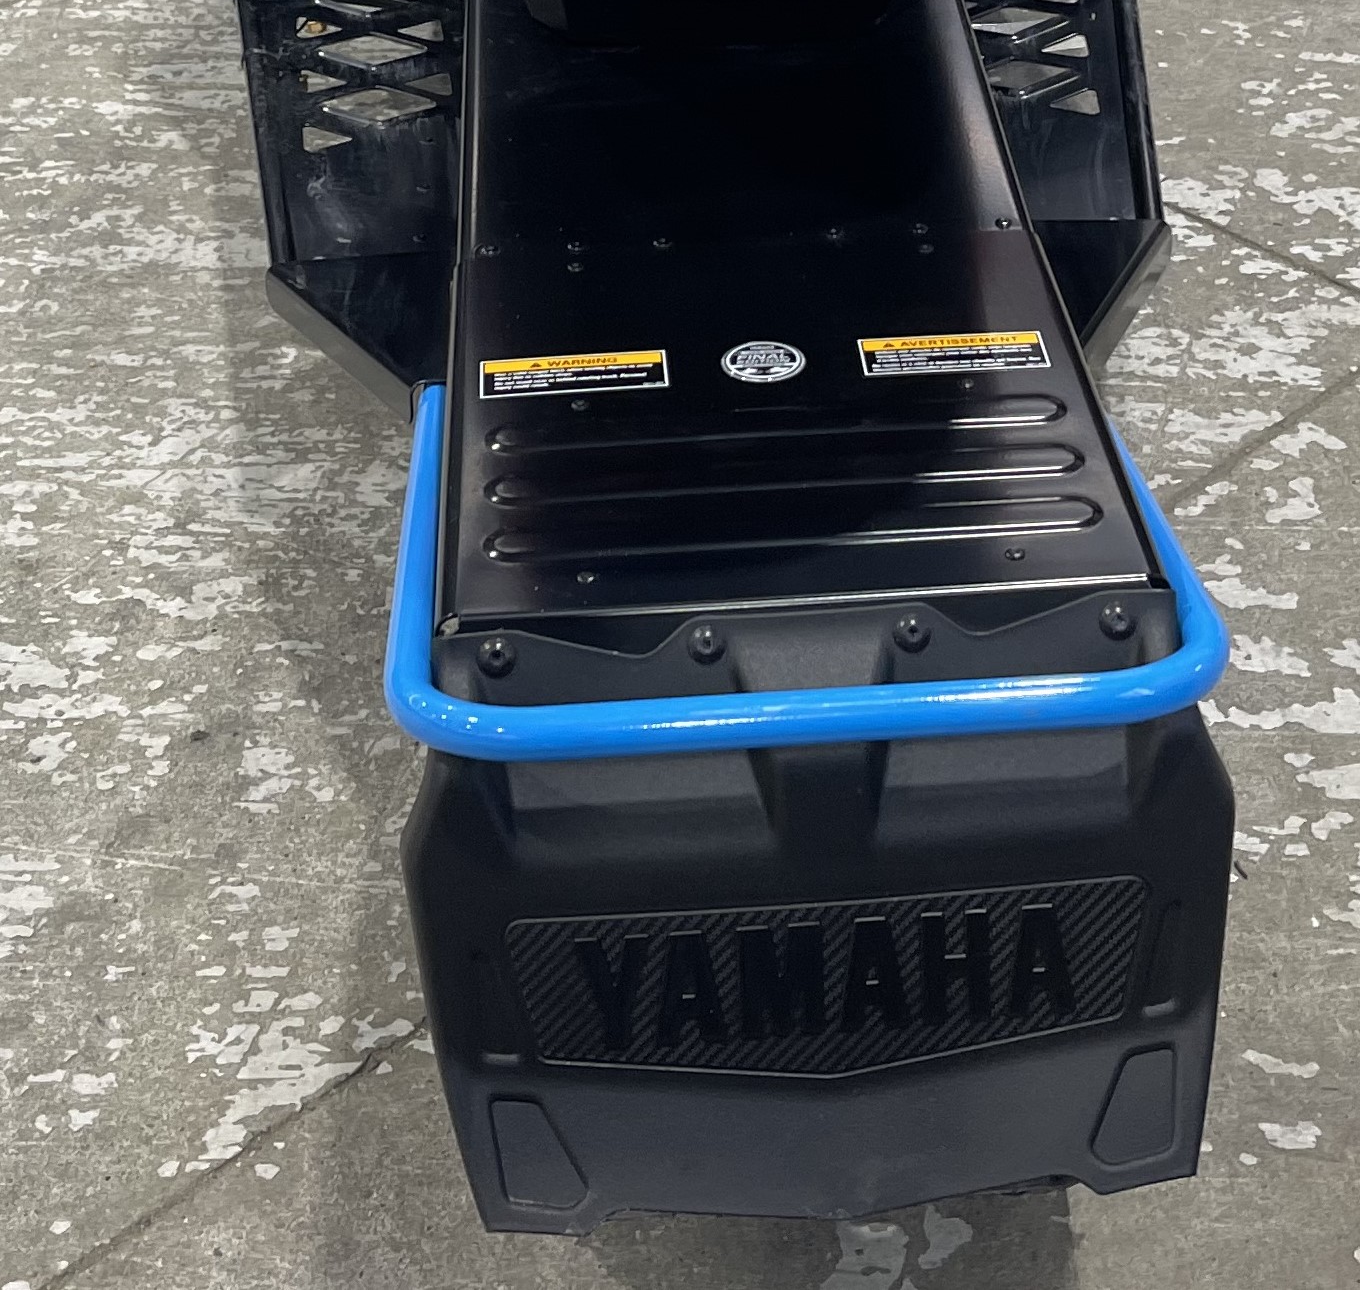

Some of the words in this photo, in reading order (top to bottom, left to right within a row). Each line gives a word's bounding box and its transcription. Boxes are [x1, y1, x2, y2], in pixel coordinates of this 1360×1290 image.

[900, 336, 1018, 347] AVERTISSEMENT
[546, 356, 619, 368] WARNING
[737, 350, 791, 364] FINAL
[573, 902, 1078, 1051] YAMAHA
